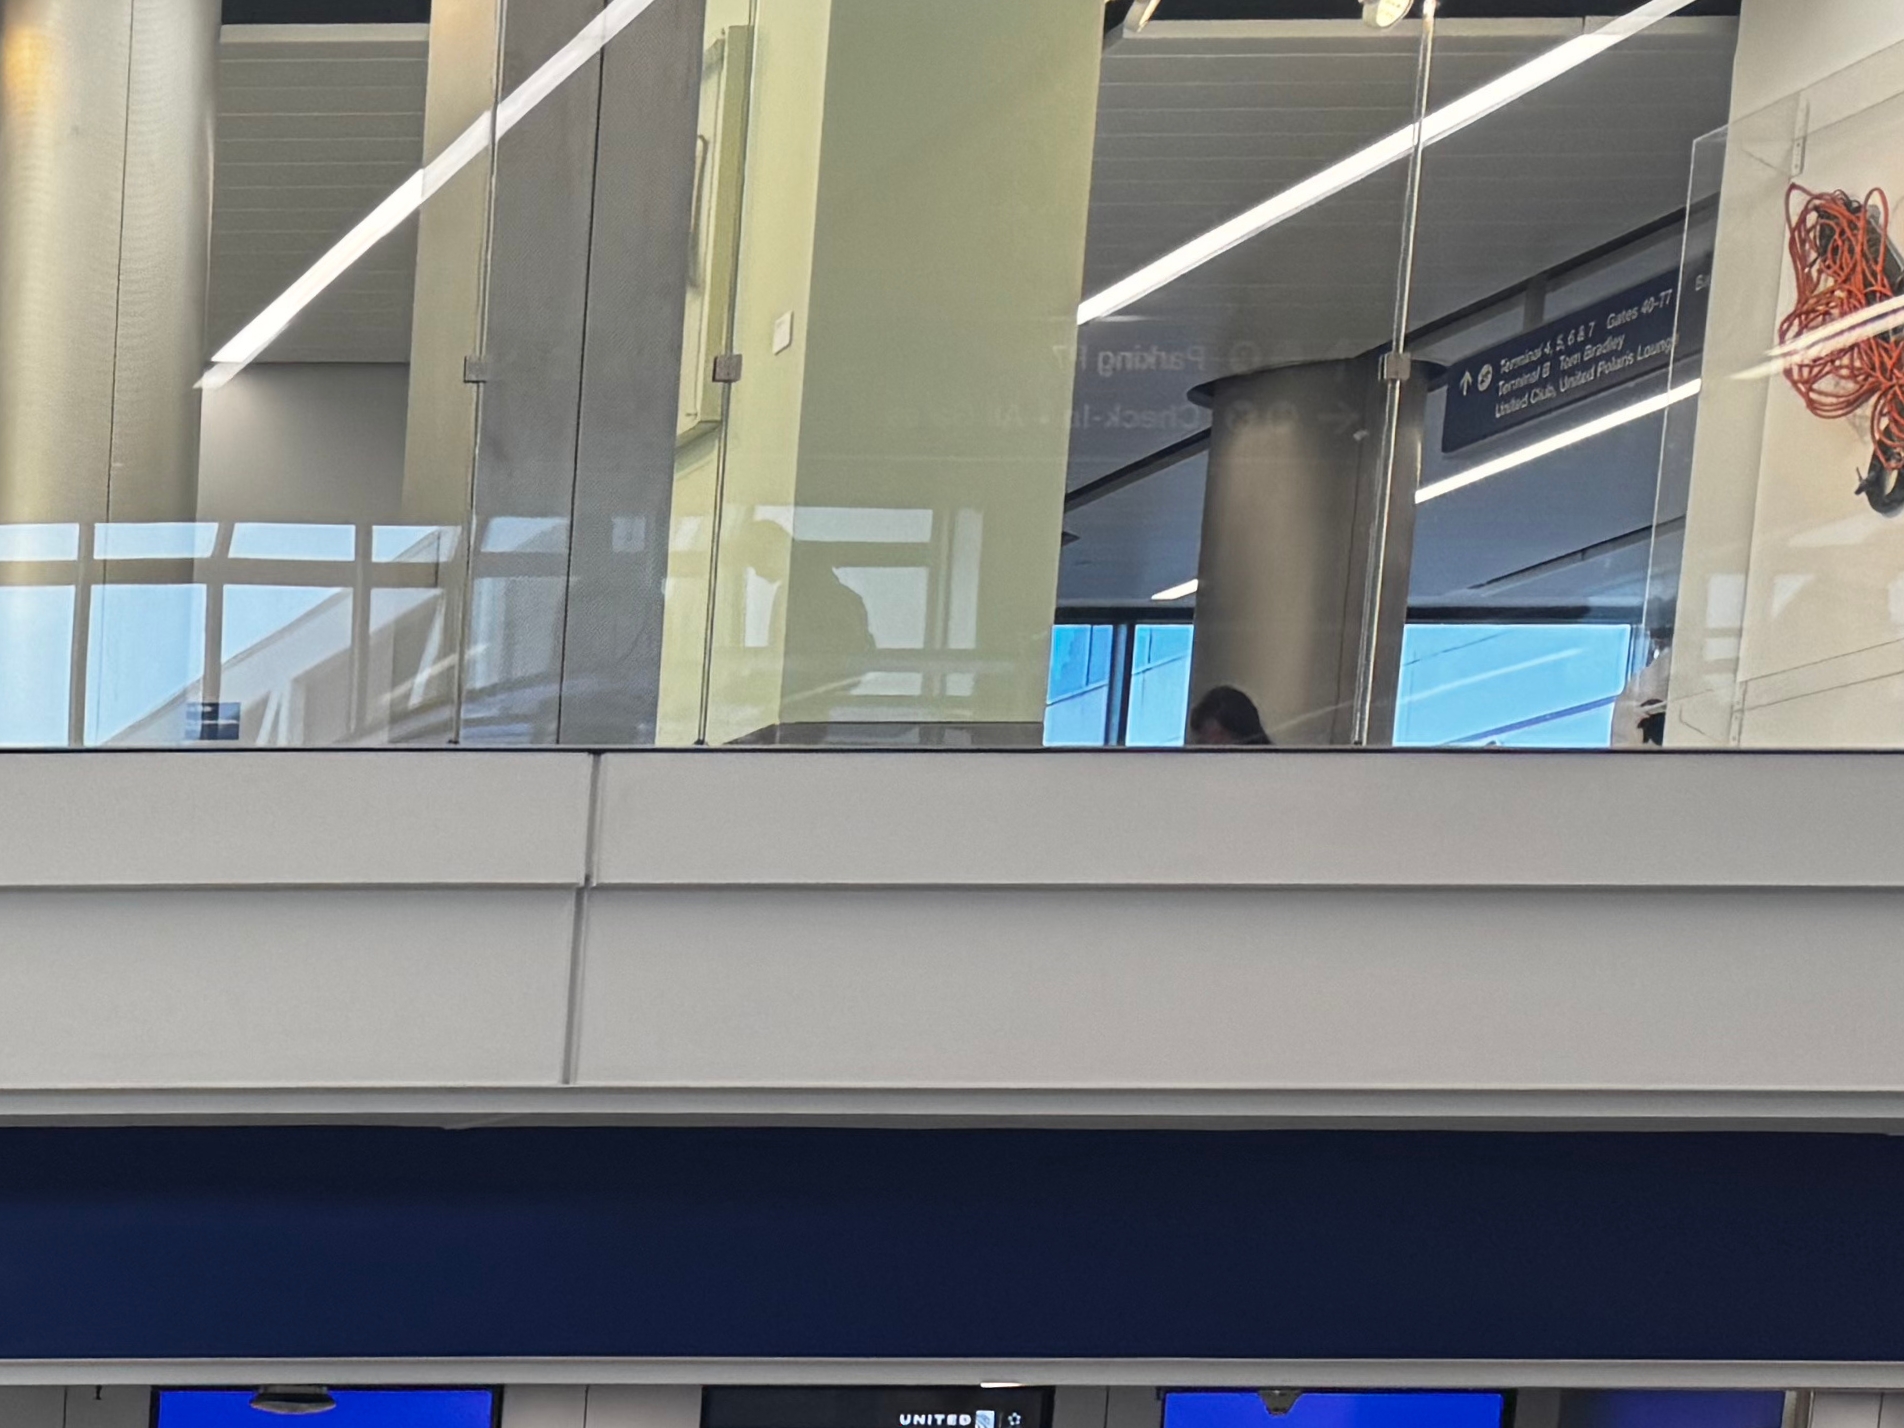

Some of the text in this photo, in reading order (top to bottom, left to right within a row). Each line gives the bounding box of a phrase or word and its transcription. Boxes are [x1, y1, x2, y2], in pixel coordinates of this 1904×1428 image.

[1500, 346, 1542, 374] Terminal
[1588, 321, 1596, 339] 7
[1606, 304, 1638, 330] Gates
[1641, 288, 1673, 315] 40-77
[1495, 391, 1527, 418] United
[1559, 367, 1594, 393] United
[1597, 349, 1634, 376] Polaris
[1498, 369, 1540, 397] Terminal
[1559, 350, 1581, 371] Tom
[1583, 333, 1625, 360] Bradley
[899, 1413, 972, 1426] UNITED
